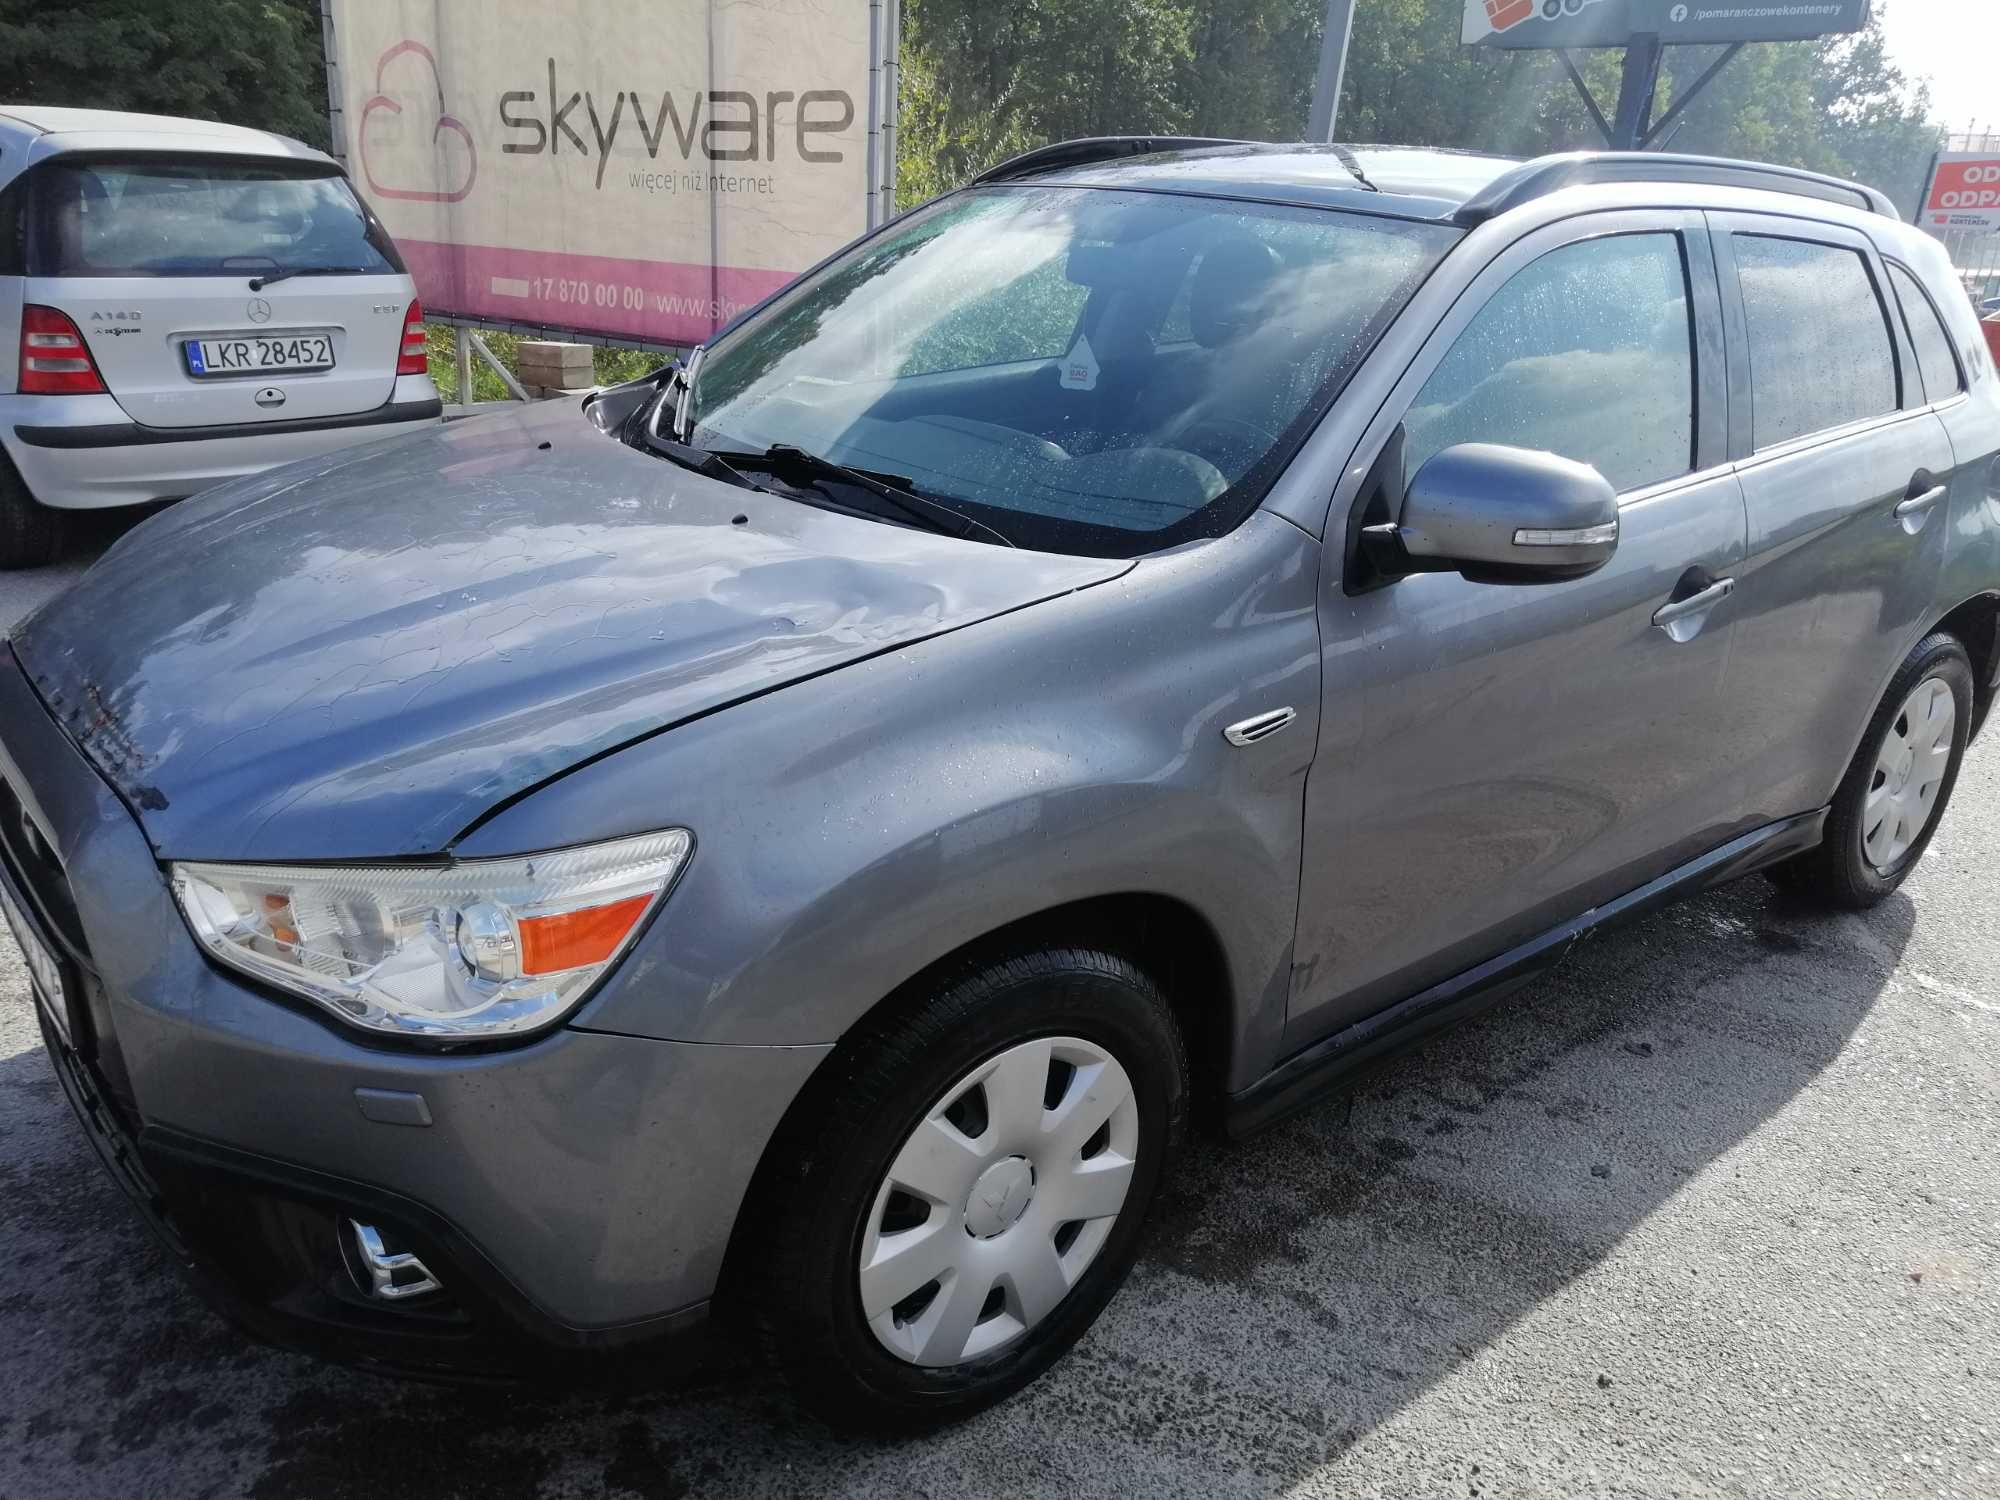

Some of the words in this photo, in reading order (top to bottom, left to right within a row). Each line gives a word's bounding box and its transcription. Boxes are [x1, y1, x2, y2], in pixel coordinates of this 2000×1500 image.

[499, 57, 855, 190] skyware
[628, 168, 676, 195] więcej
[681, 169, 702, 192] niż
[533, 277, 553, 301] 17
[559, 279, 589, 304] 870
[595, 283, 617, 308] 00
[623, 286, 644, 311] 00
[203, 342, 251, 369] LKR
[256, 339, 329, 366] 28452
